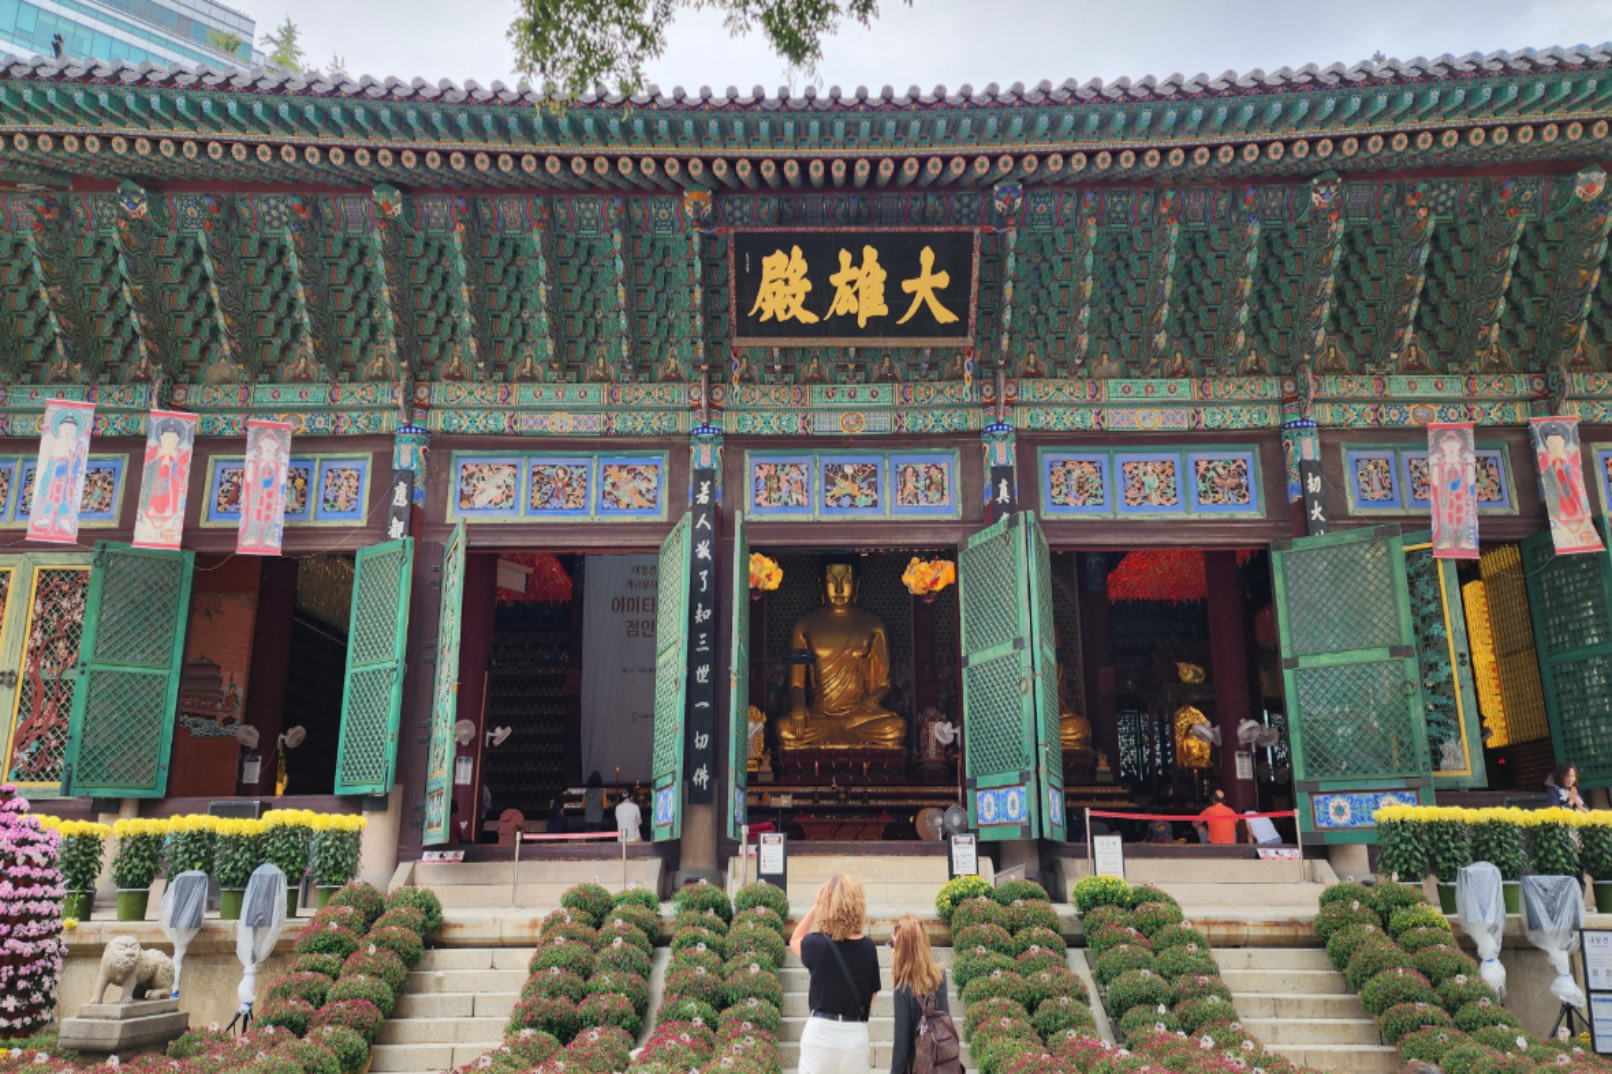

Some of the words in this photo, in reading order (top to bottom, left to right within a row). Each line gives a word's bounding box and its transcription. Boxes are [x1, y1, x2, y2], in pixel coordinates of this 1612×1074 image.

[747, 244, 960, 329] 大雄殿
[611, 596, 656, 614] 아미타
[626, 619, 655, 638] 점안
